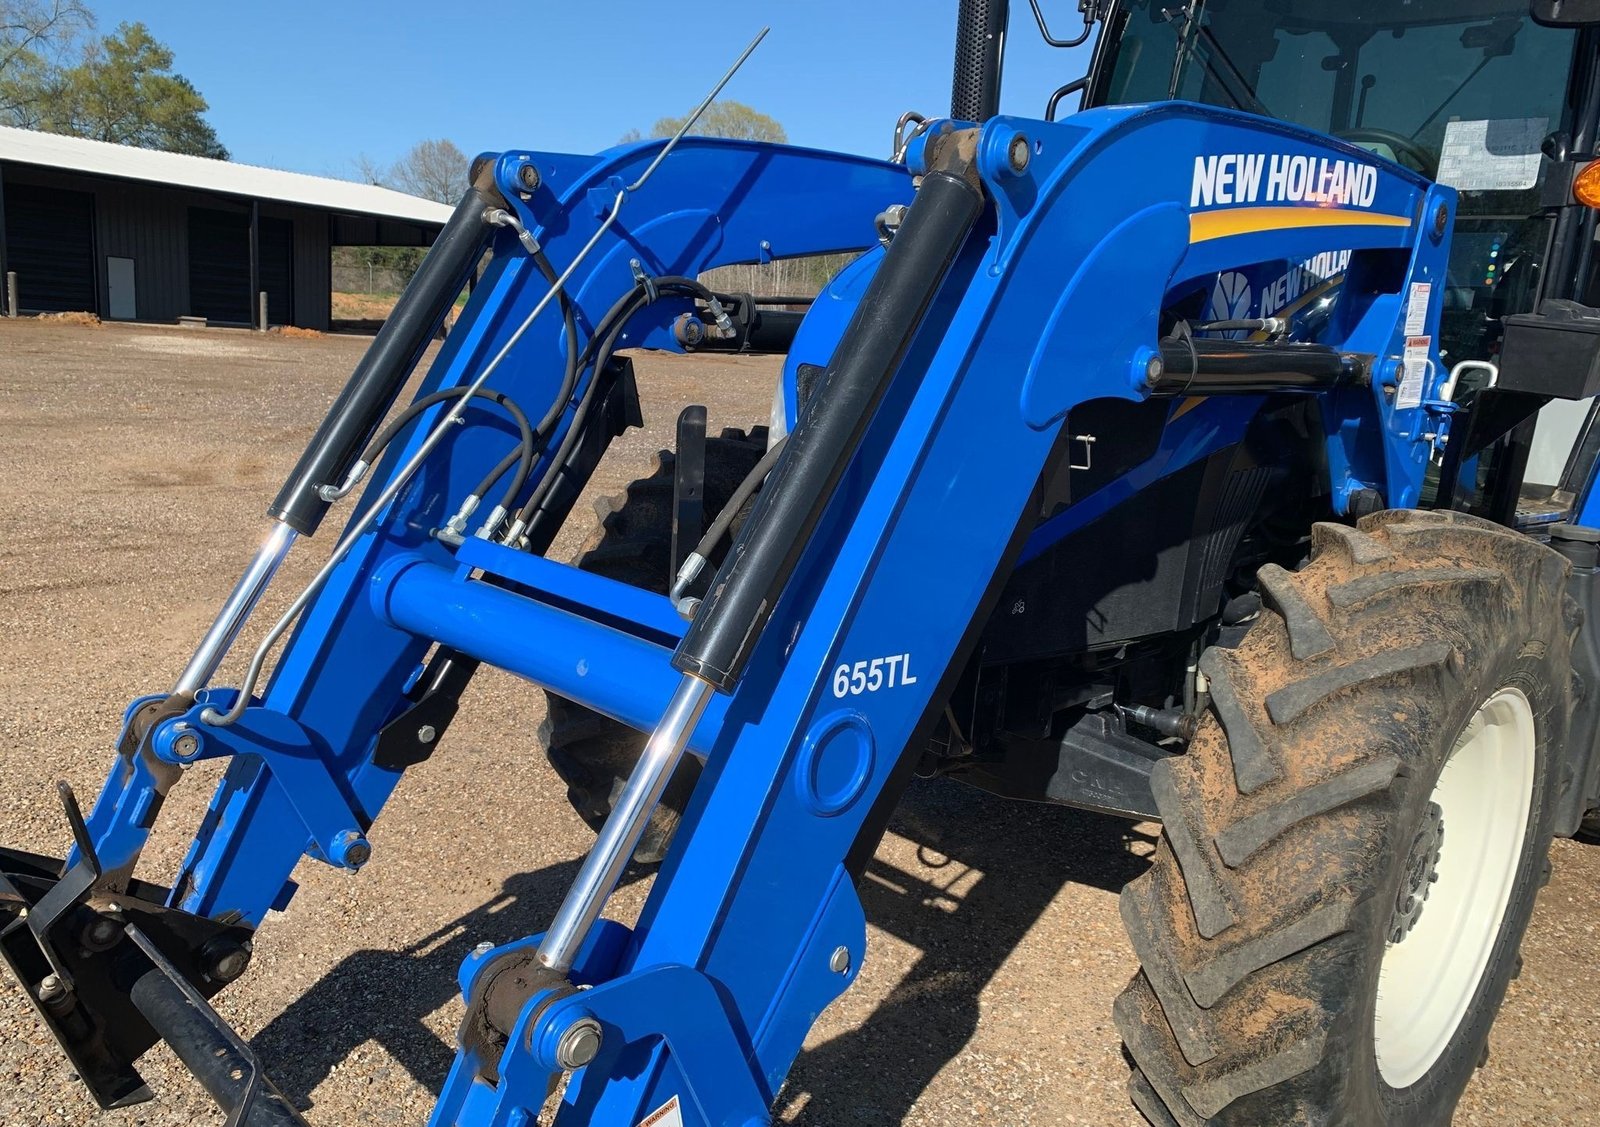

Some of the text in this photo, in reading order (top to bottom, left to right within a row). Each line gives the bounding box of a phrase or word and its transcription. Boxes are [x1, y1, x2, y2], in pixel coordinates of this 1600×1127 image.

[1190, 154, 1377, 208] NEW HOLLAND
[1260, 263, 1303, 318] NEW
[833, 653, 917, 699] 655TL
[644, 1101, 676, 1127] WARNING
